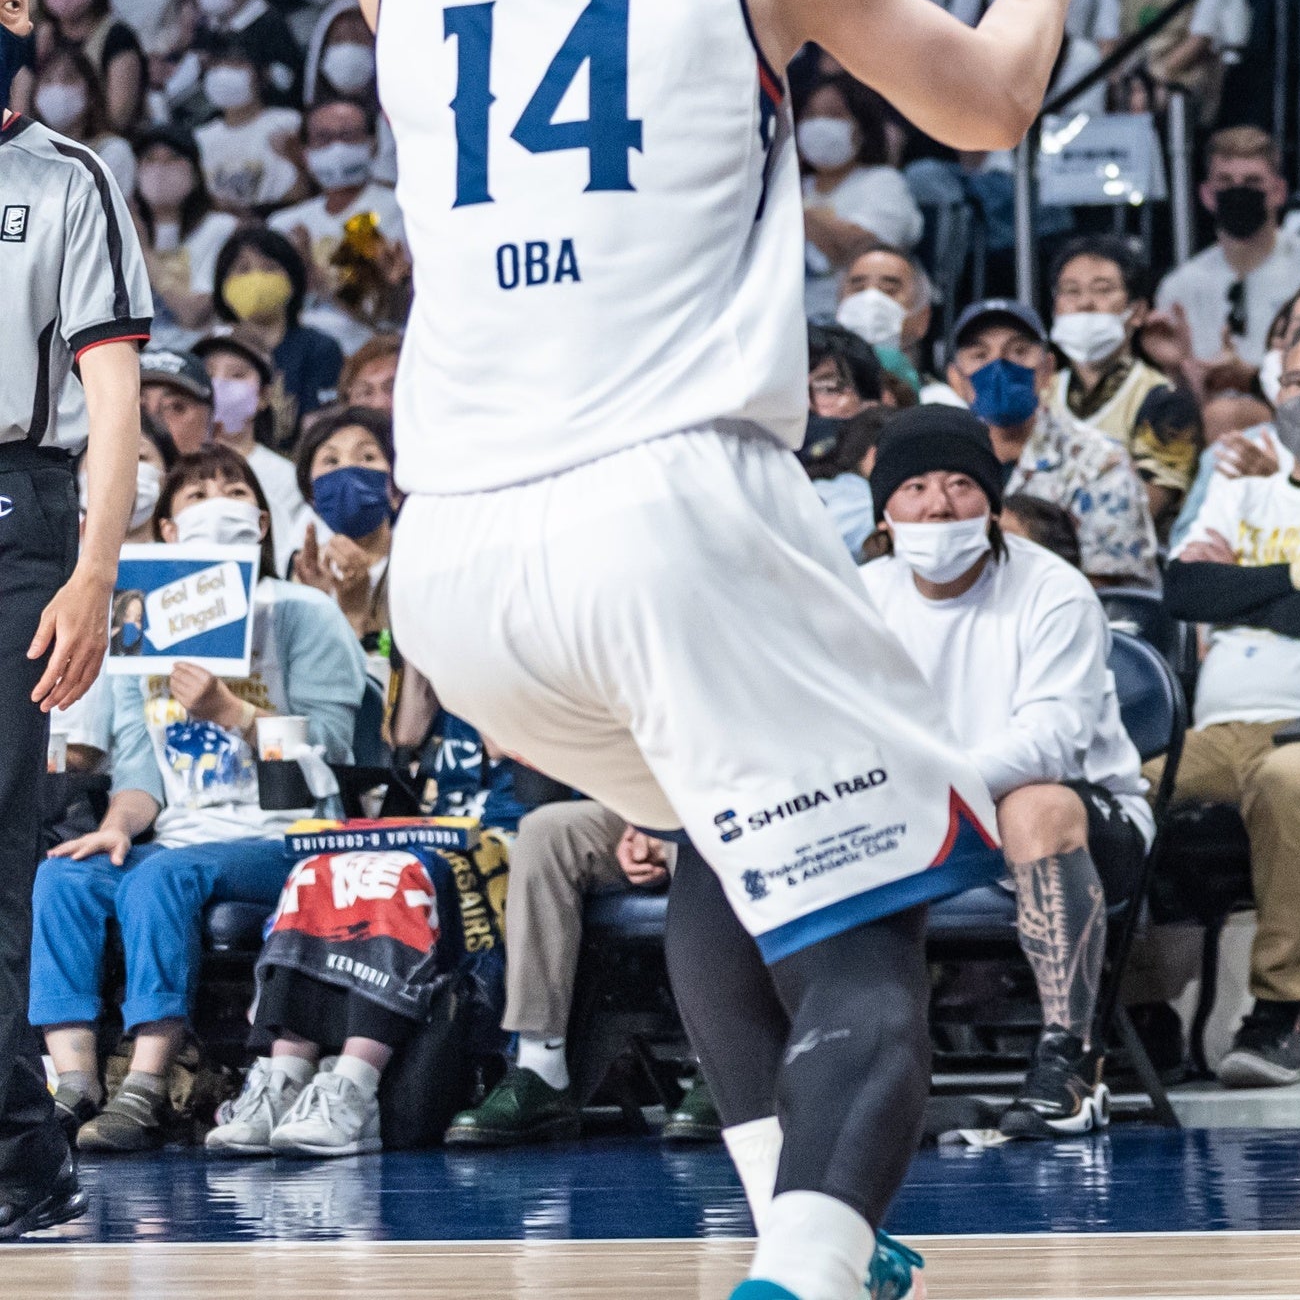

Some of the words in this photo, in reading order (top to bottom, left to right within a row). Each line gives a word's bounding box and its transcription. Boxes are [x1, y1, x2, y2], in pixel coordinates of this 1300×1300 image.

[496, 238, 582, 289] OBA
[748, 790, 830, 831] SHIBA
[833, 768, 888, 798] R&D
[851, 823, 907, 849] Country
[865, 838, 899, 857] Club
